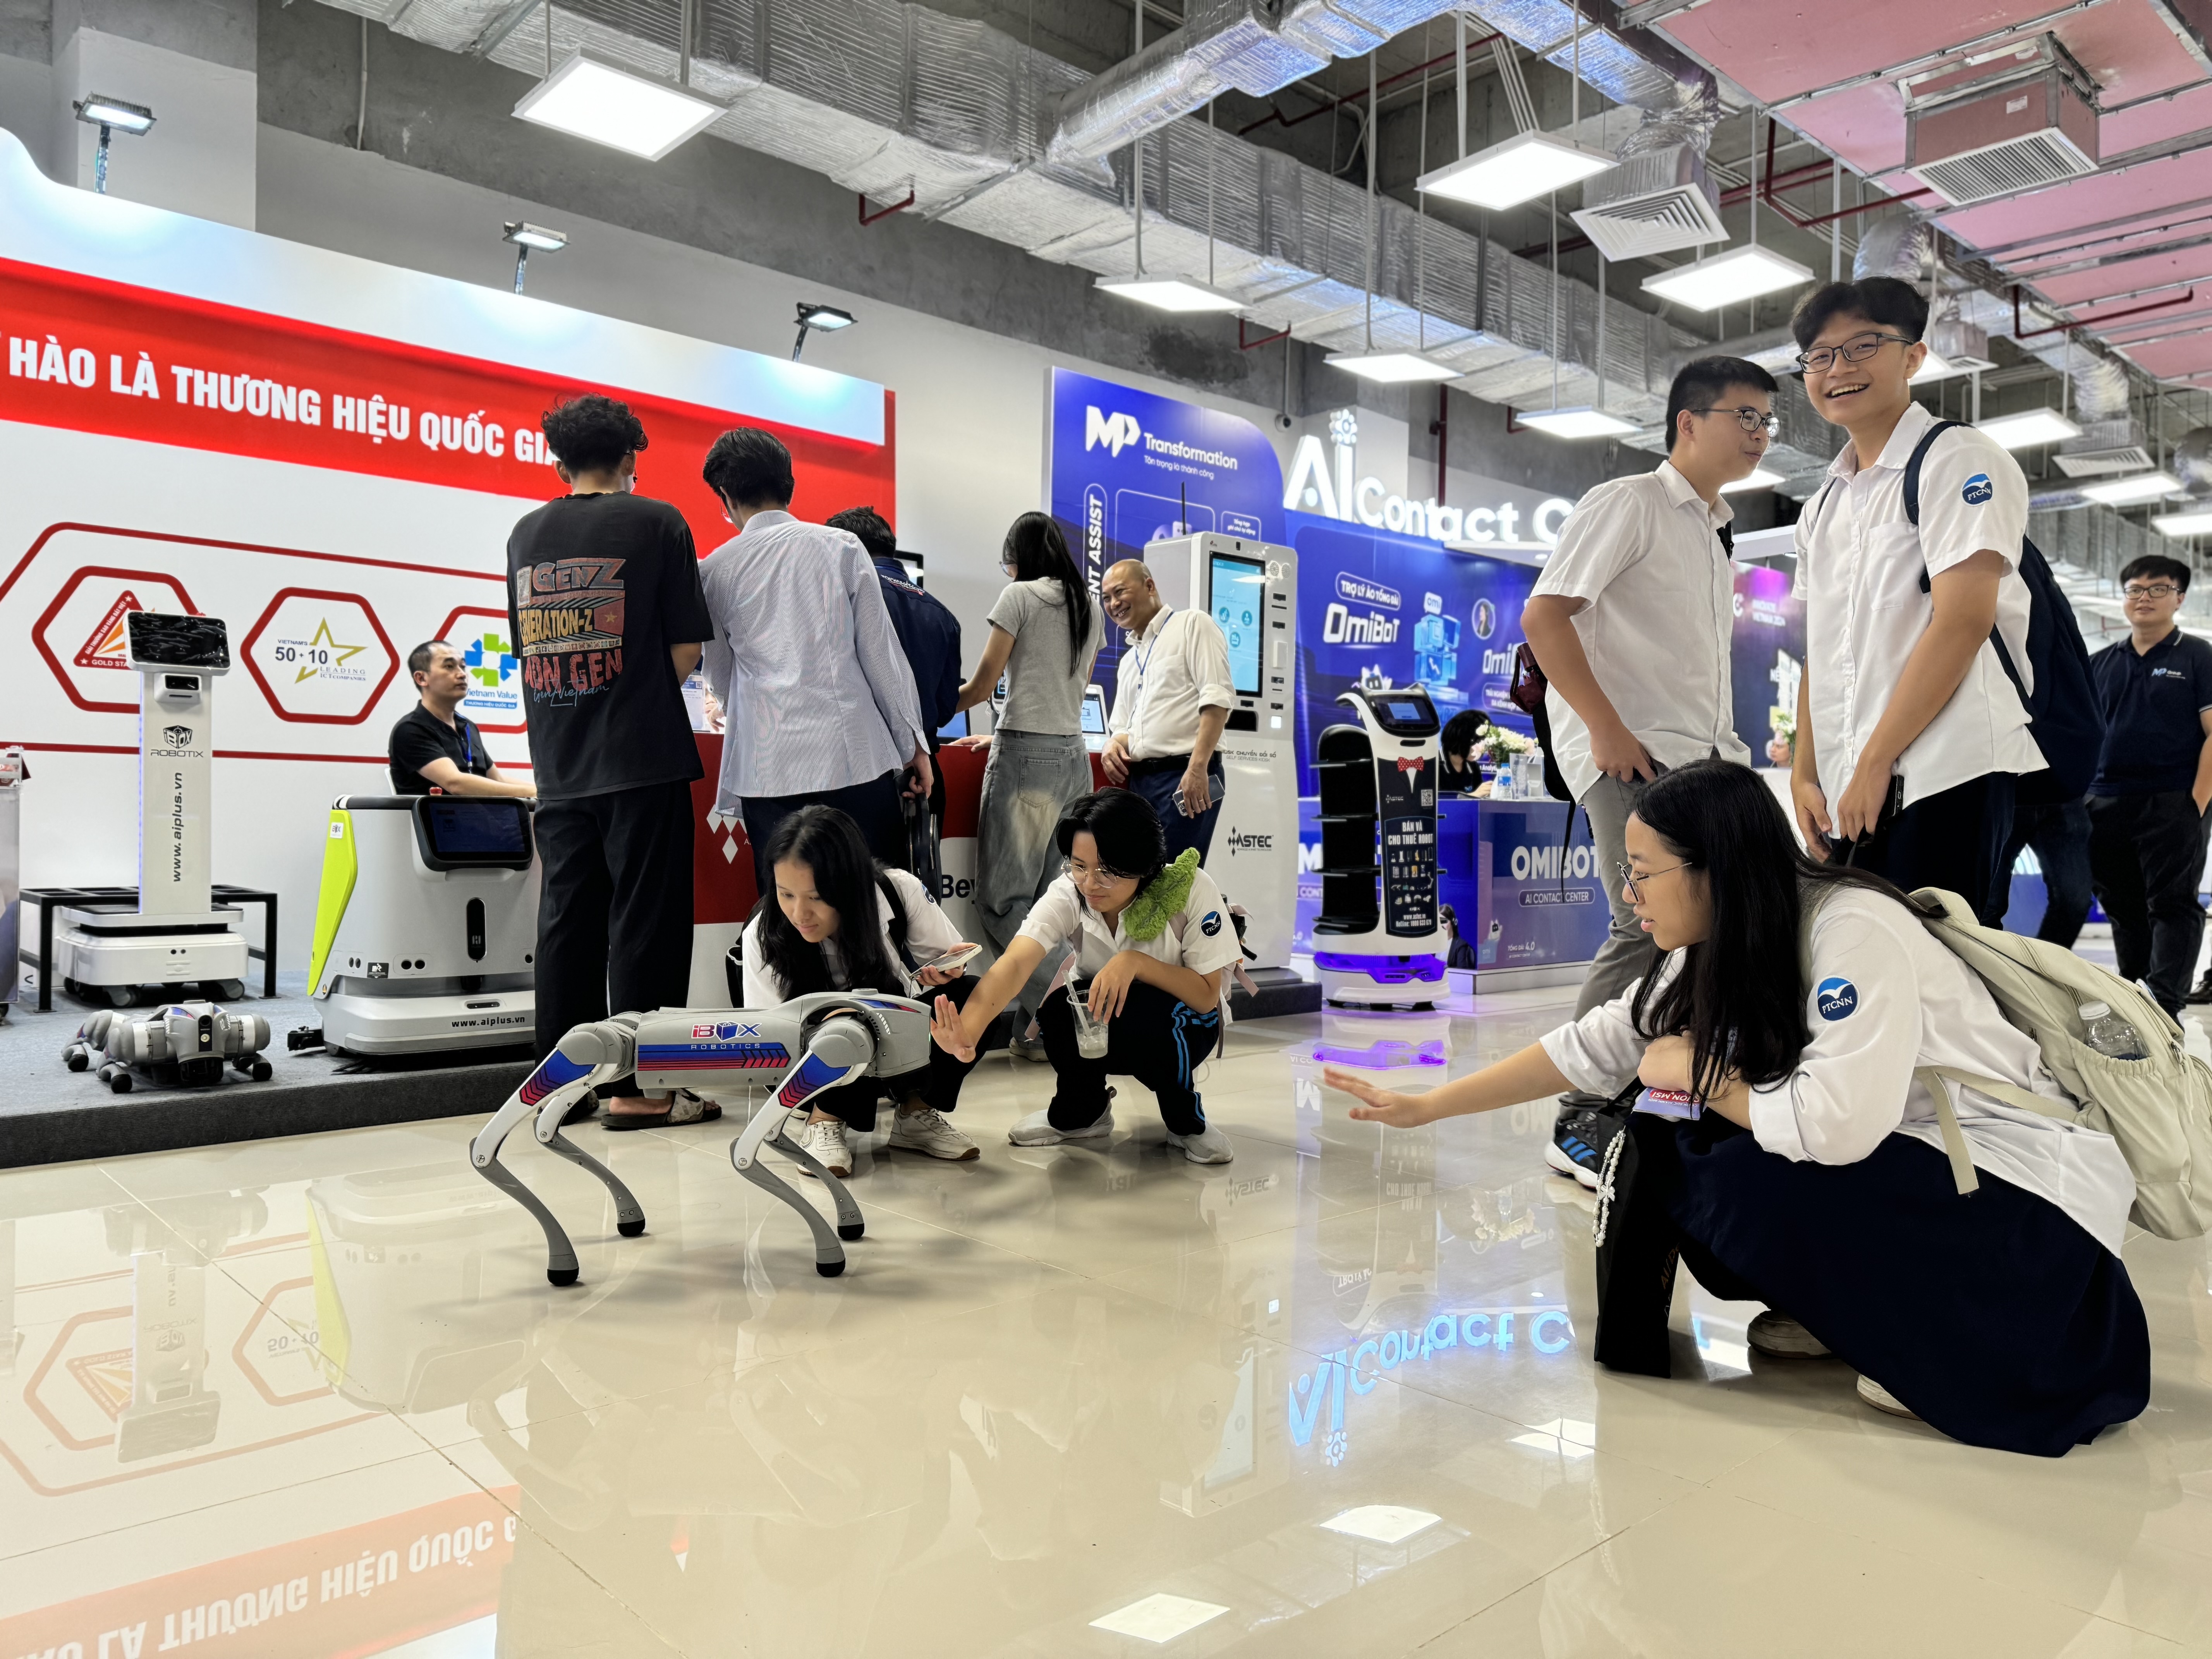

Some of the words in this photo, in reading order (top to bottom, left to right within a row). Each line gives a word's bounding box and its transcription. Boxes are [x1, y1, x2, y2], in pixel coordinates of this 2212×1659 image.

[10, 335, 95, 388] HÀO
[110, 352, 160, 398] LÀ
[172, 365, 320, 425] THƯƠNG
[333, 393, 409, 444] HIỆU
[420, 410, 504, 457] QUỐC
[1086, 405, 1141, 458] MP
[1144, 432, 1238, 470] Transformation
[1144, 455, 1155, 465] Tôn
[1156, 459, 1173, 471] trọng
[1174, 461, 1180, 471] là
[1181, 463, 1198, 475] thành
[1199, 468, 1214, 480] công
[1967, 487, 1991, 501] PTCNN
[1354, 477, 1519, 542] Contact
[1089, 494, 1103, 565] ASSIST
[1341, 580, 1357, 598] TRỢ
[1357, 584, 1365, 597] LÝ
[1366, 585, 1375, 599] ẢO
[1376, 588, 1391, 603] TỔNG
[1427, 596, 1441, 609] omi
[275, 646, 295, 662] 50
[308, 649, 328, 665] 10
[320, 666, 365, 675] LEADING
[570, 649, 623, 691] GEN
[497, 690, 517, 699] Value
[151, 749, 204, 757] ROBOTIX
[1402, 820, 1414, 832] BÁN
[1415, 819, 1423, 831] VÀ
[1237, 833, 1272, 848] ASTEC
[1388, 835, 1401, 845] CHO
[1402, 833, 1417, 845] THUÊ
[1418, 833, 1433, 844] ROBOT
[1511, 845, 1599, 881] OMIBOT
[1525, 894, 1532, 904] AI
[1565, 891, 1589, 902] CENTER
[1525, 941, 1535, 951] 4.0
[1822, 996, 1853, 1014] PTCNN
[452, 1016, 525, 1027] www.aiplus.vn
